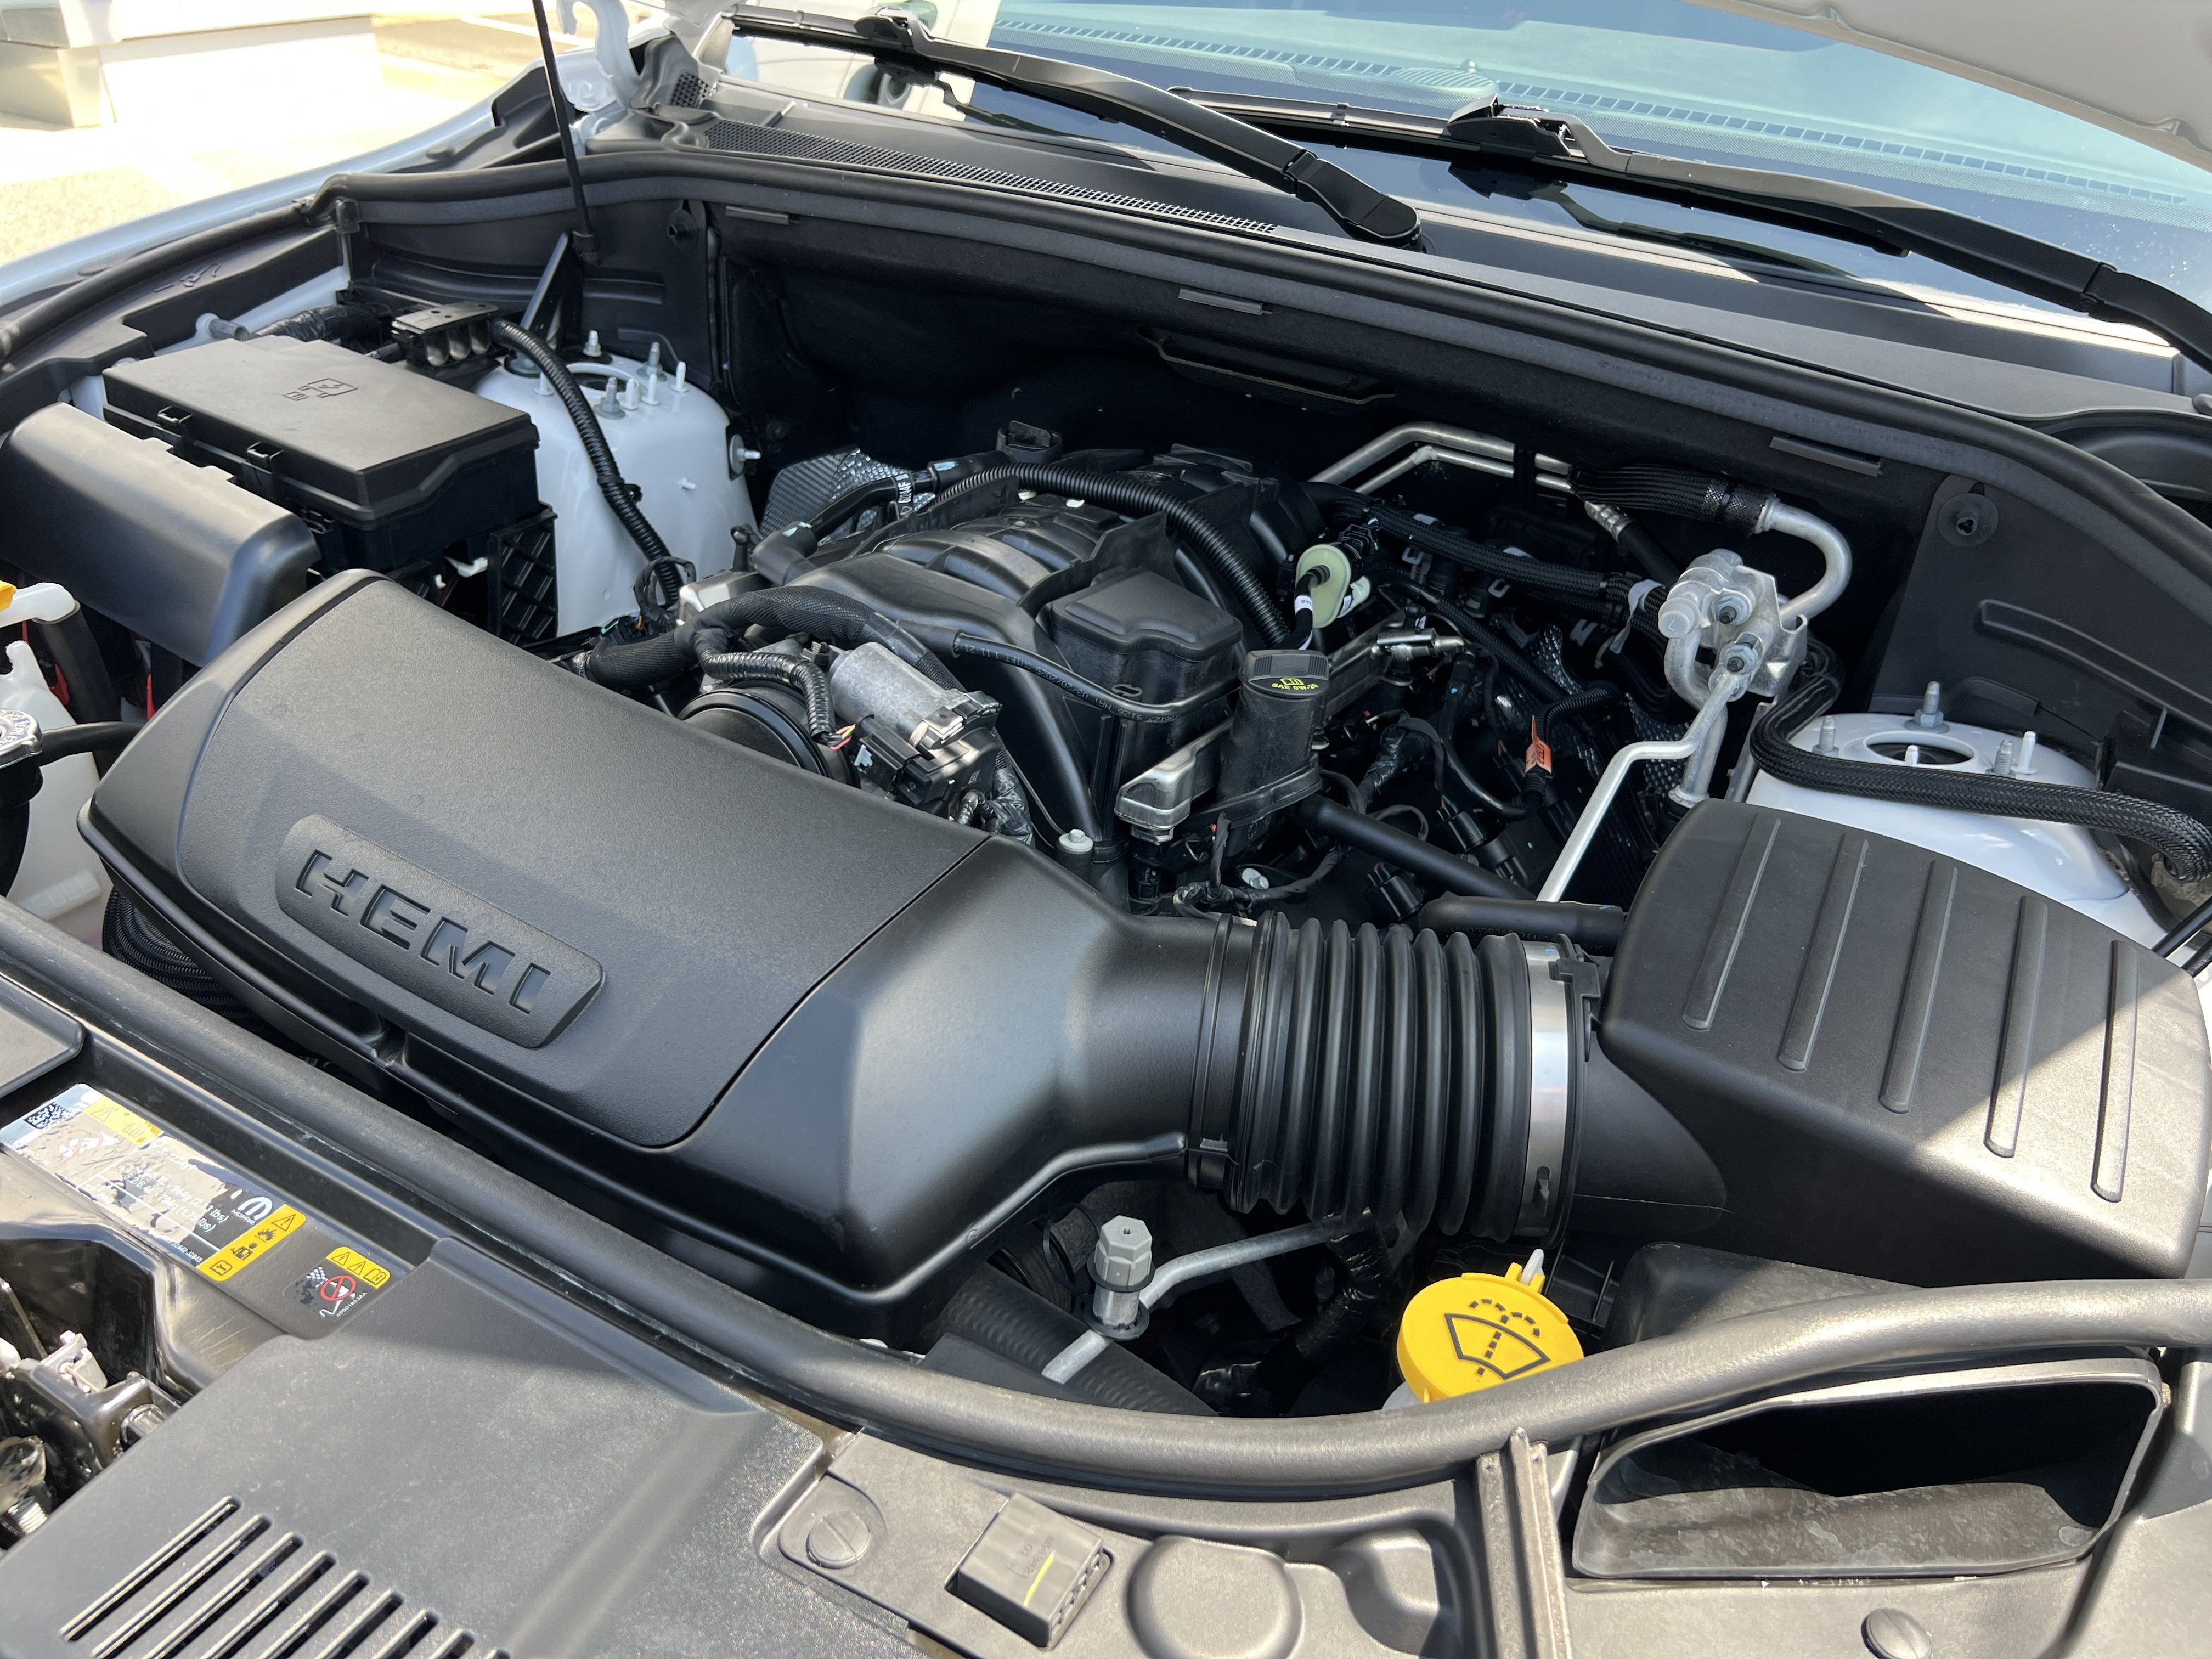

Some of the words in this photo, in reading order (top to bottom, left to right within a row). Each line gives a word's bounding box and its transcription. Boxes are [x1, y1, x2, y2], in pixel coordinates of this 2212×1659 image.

[294, 849, 551, 1014] HEMI
[171, 1184, 190, 1201] 964g
[209, 1208, 230, 1223] lbs)
[230, 1209, 256, 1226] MOPAR
[196, 1217, 216, 1233] lbs)
